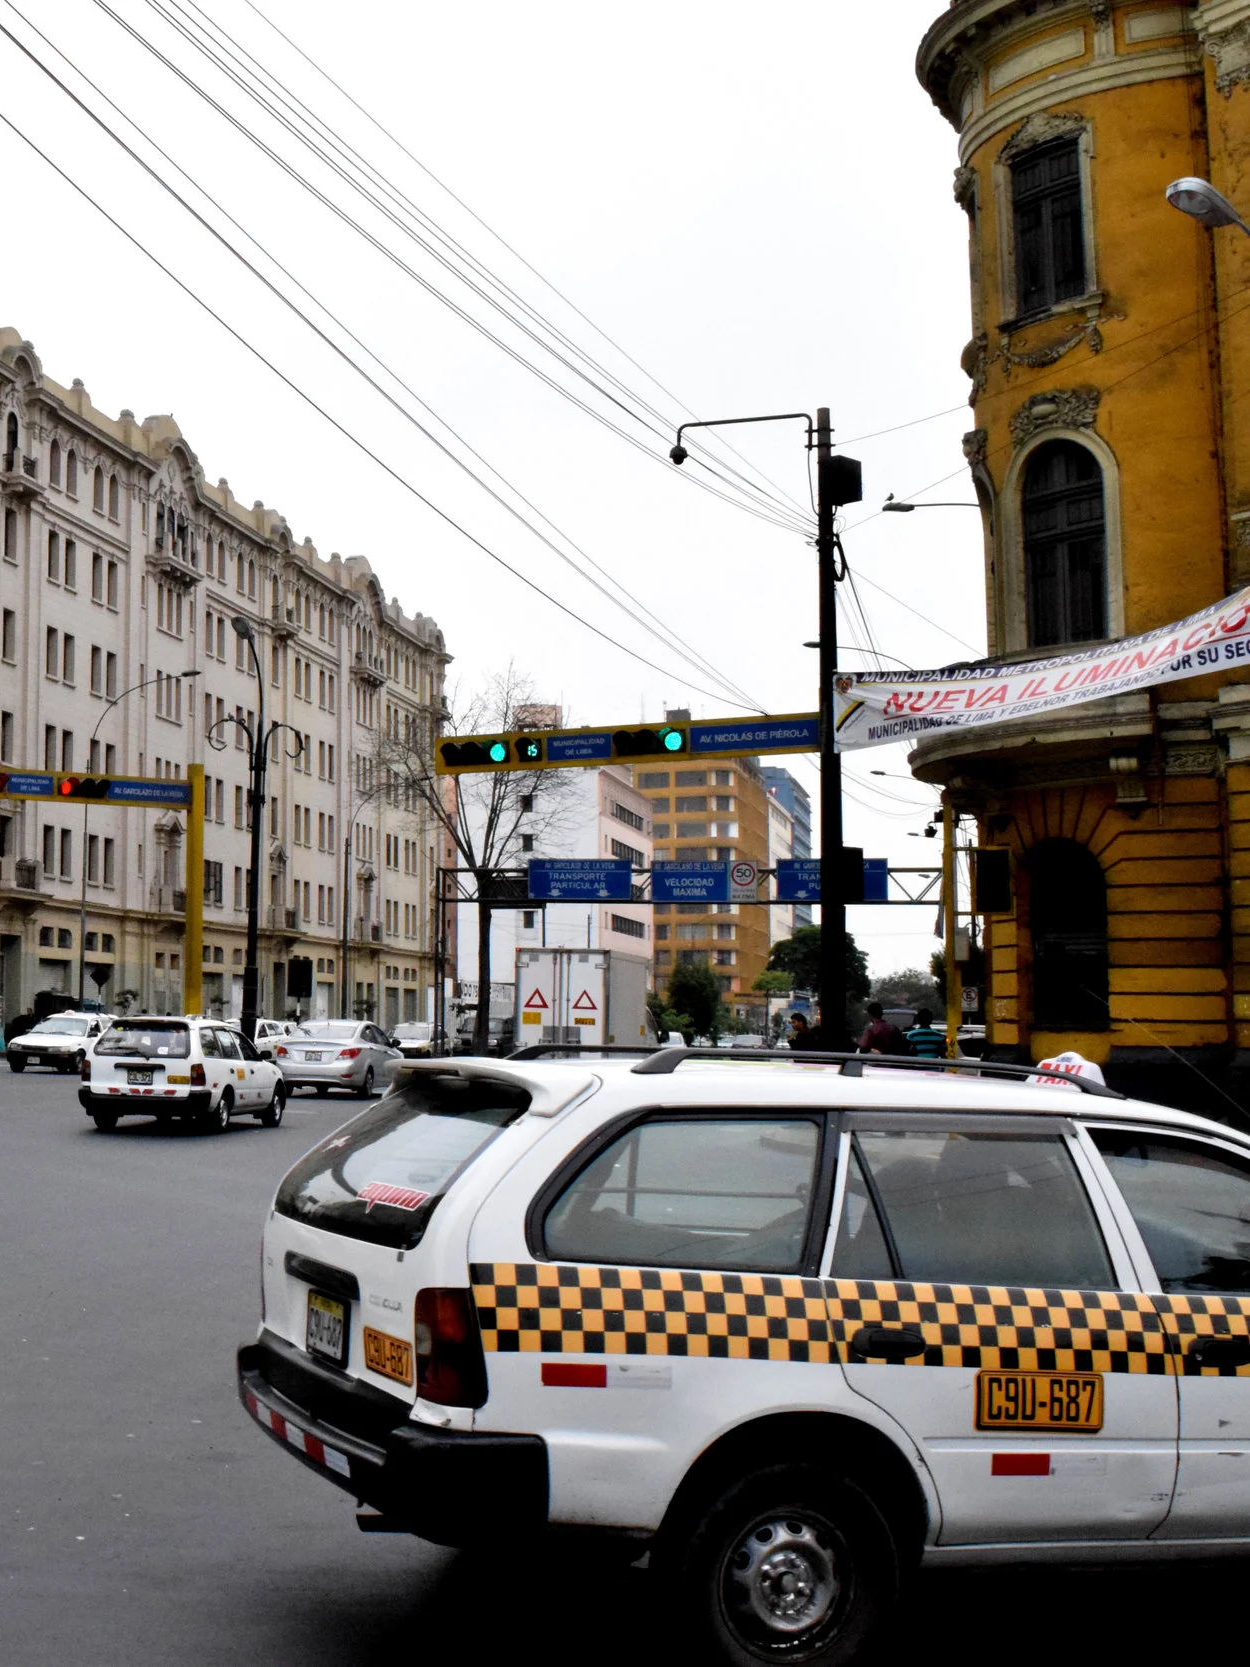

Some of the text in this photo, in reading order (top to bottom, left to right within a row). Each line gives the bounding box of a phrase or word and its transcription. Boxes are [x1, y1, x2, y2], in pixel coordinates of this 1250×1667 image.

[860, 606, 1215, 683] MUNICIPALIDAD METROPOLITANA DE LIMA
[868, 717, 942, 741] MUNICIPALIDAD
[945, 716, 963, 726] DE
[964, 710, 994, 723] LIMA
[999, 708, 1009, 718] Y
[1009, 694, 1070, 715] EDELNOR
[1197, 647, 1219, 666] SU
[883, 684, 1008, 715] NUEVA
[755, 731, 767, 740] DE
[553, 738, 605, 747] MUNICIPALIDAD
[548, 872, 606, 880] TRANSPORTE
[736, 868, 752, 878] 50
[550, 881, 606, 889] PARTICULAR
[664, 878, 715, 887] VELOCIDAD
[366, 1333, 410, 1379] C9U-687
[988, 1377, 1096, 1422] C9U-687
